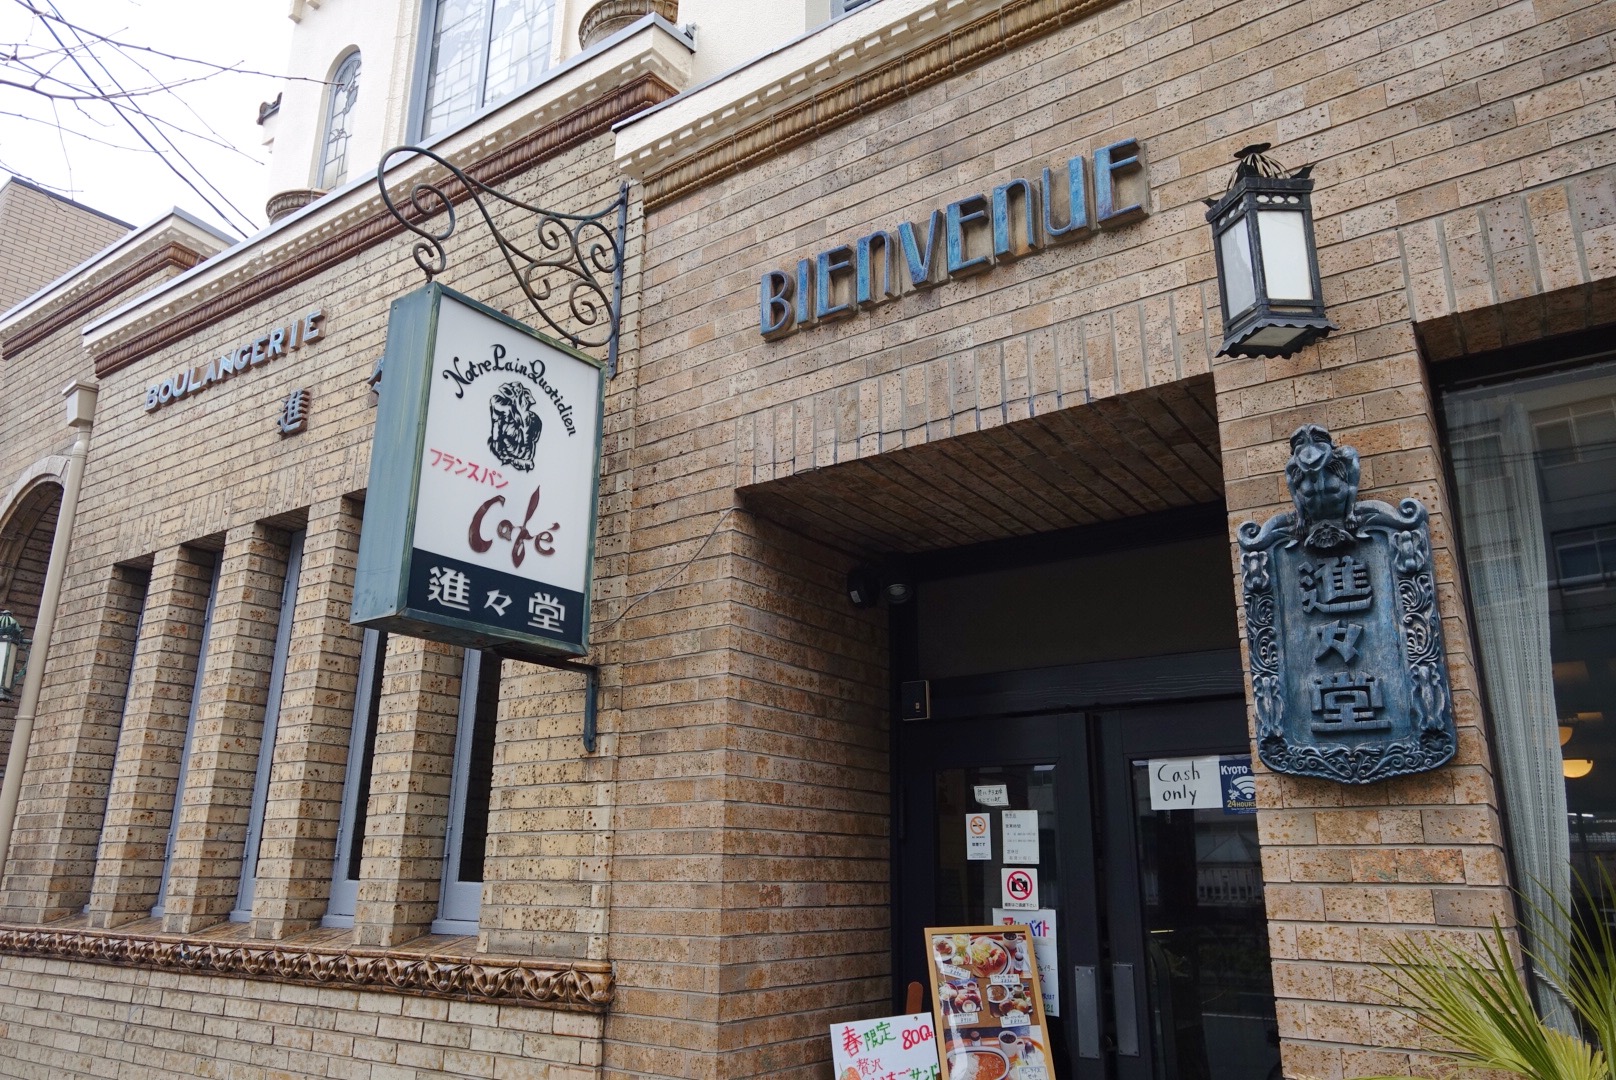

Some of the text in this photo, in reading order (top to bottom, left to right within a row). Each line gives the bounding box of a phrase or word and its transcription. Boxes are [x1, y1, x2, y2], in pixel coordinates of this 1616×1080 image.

[760, 137, 1149, 340] BIENVENUE
[144, 308, 327, 413] BOULANGERIE
[442, 344, 577, 437] Notre Pain Quotidien
[429, 448, 509, 489] フランスパン
[468, 485, 561, 569] Café
[427, 566, 565, 633] 進々堂
[1299, 555, 1391, 732] 進々堂
[1157, 761, 1201, 782] Cash
[1162, 784, 1197, 806] only
[1220, 765, 1248, 775] KYOTO
[841, 1021, 934, 1058] 春限定 800円
